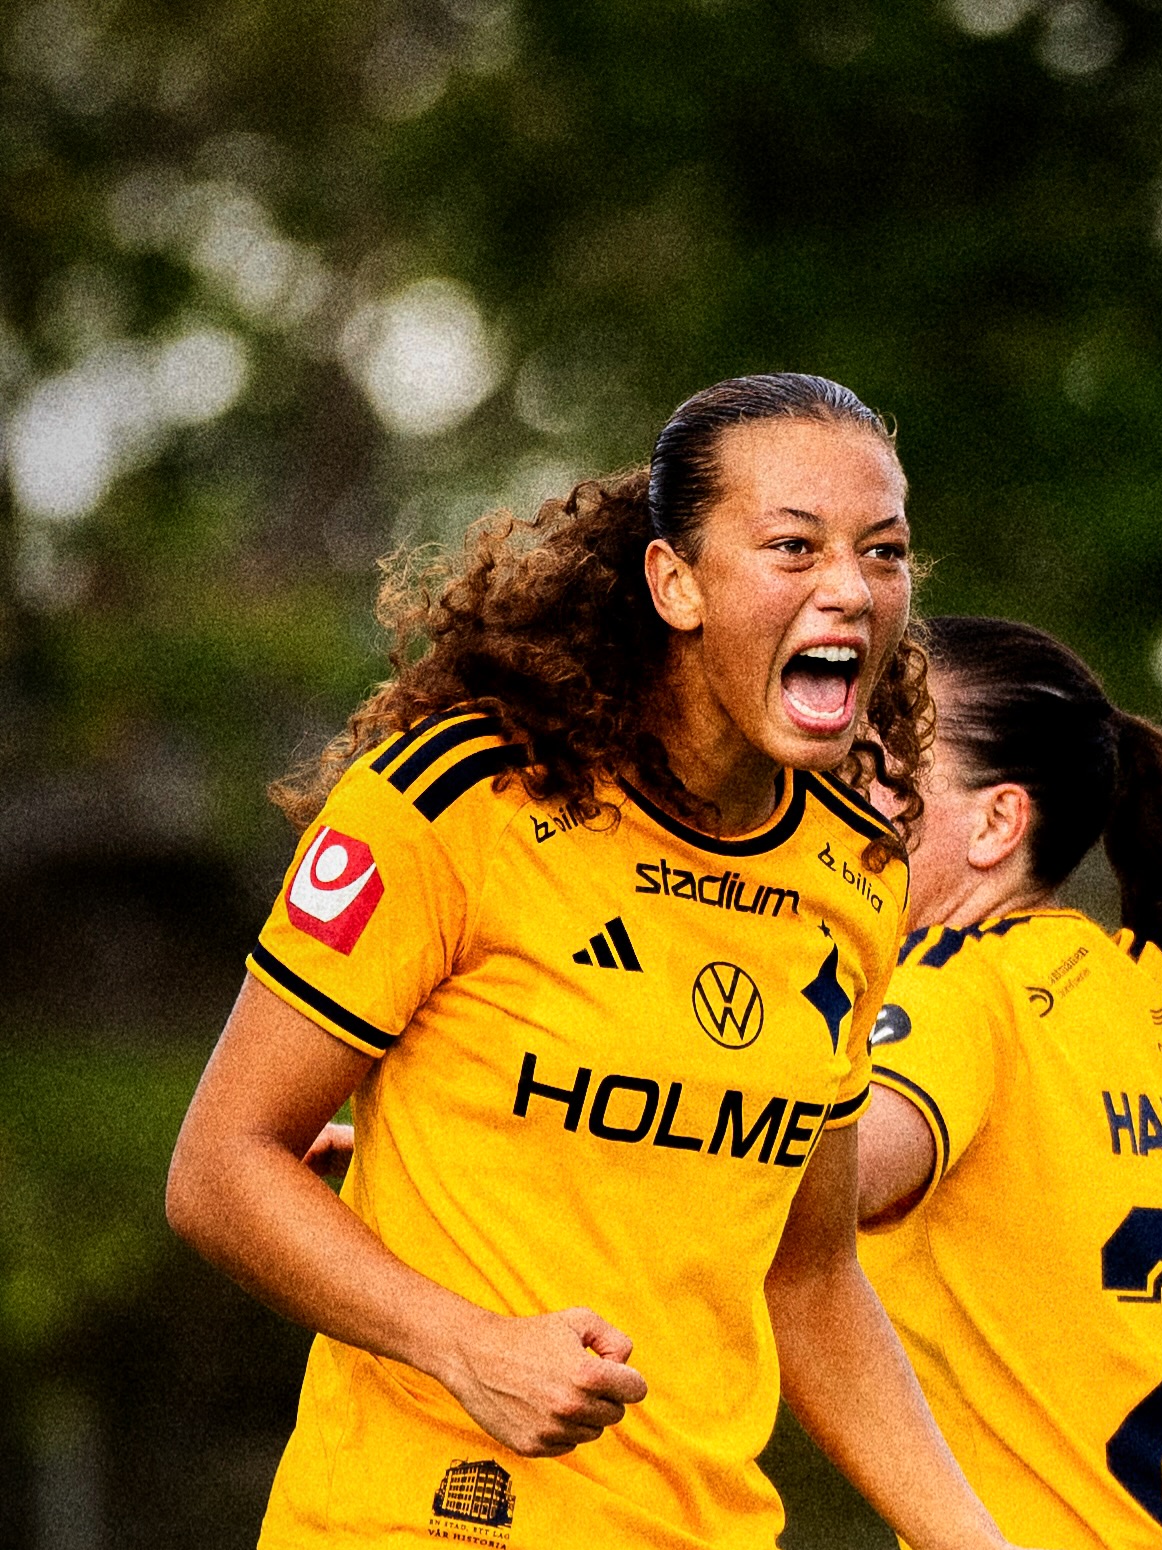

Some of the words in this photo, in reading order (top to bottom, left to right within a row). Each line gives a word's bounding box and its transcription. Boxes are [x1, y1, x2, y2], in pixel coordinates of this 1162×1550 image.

[635, 858, 801, 918] stadium
[842, 861, 884, 914] bilia
[512, 1051, 832, 1168] HOLME
[427, 1528, 449, 1539] VÅR
[453, 1533, 507, 1550] HISTORIA
